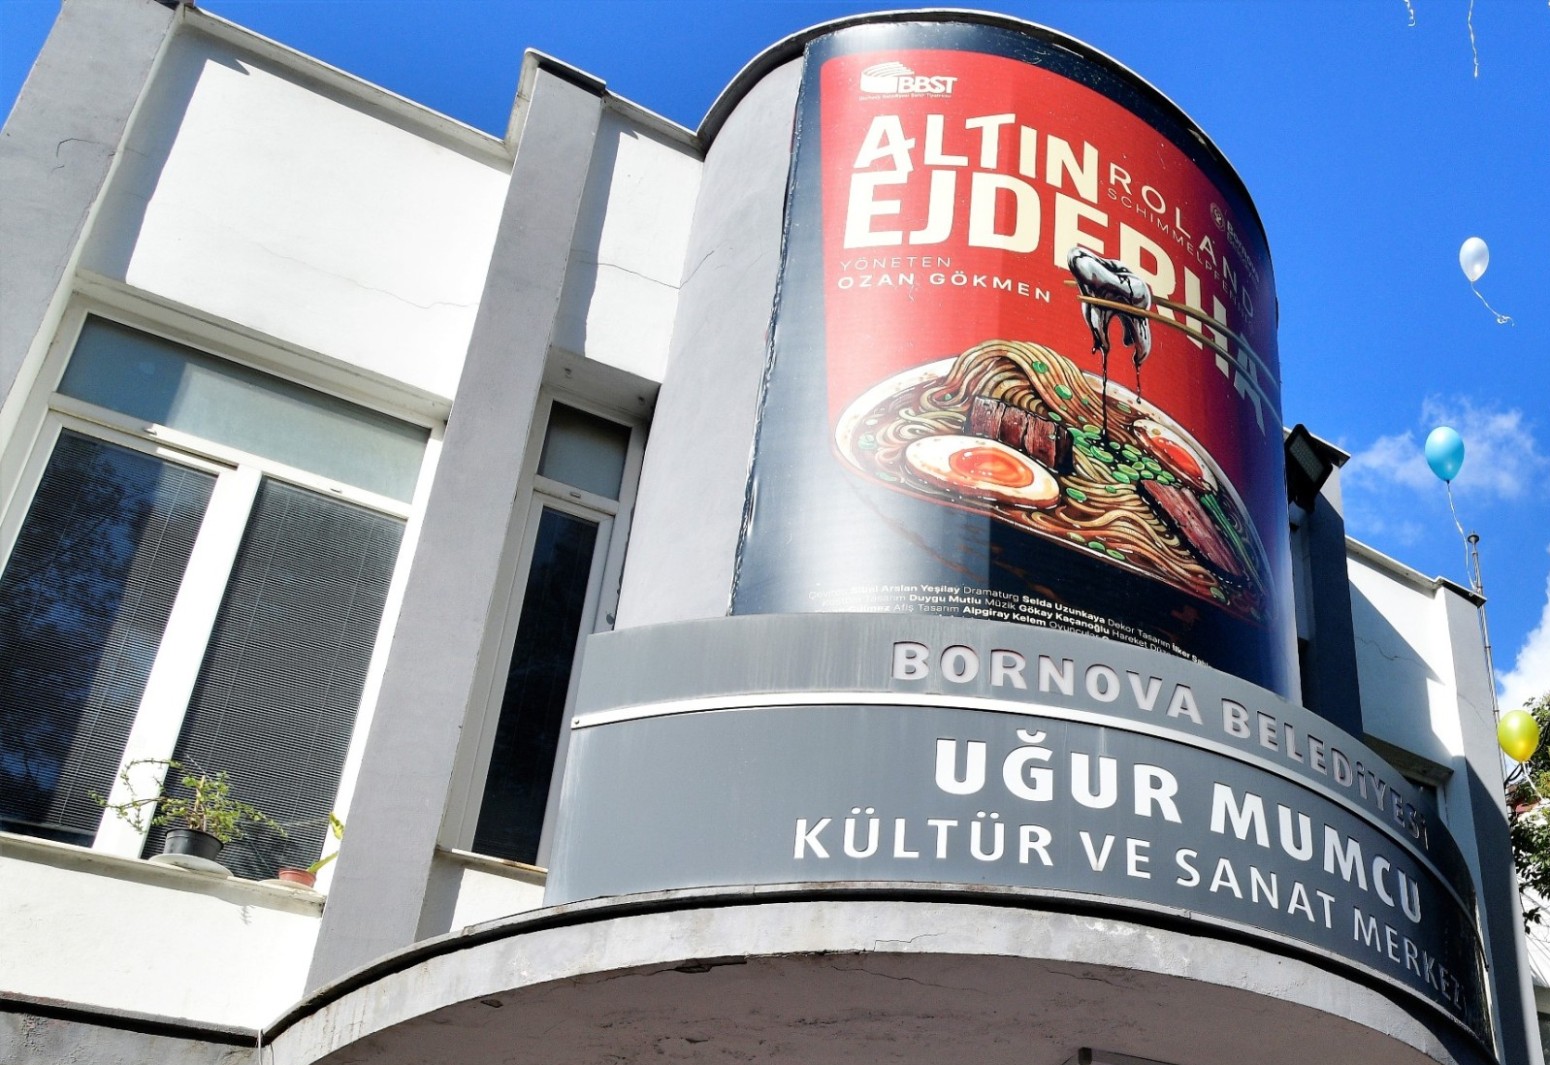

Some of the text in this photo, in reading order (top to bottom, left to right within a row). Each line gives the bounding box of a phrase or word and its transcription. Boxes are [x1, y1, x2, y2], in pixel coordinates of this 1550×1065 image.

[898, 75, 958, 94] BBST
[853, 112, 1099, 205] ALTIN
[840, 255, 951, 270] YÖNETEN
[1109, 162, 1254, 318] ROLAND
[838, 271, 1050, 304] OZAN GÖKMEN
[893, 603, 914, 613] Afiş
[917, 603, 960, 613] Tasarım
[962, 605, 1010, 621] Alpgiray
[1012, 612, 1047, 627] Kelem
[909, 594, 946, 605] Duygu
[948, 594, 982, 604] Mutlu
[984, 597, 1016, 611] Müzik
[1018, 604, 1053, 620] Gökay
[1055, 613, 1110, 636] Kaçanoğlu
[1111, 629, 1148, 651] Hareket
[920, 584, 960, 595] Yeşilay
[963, 586, 1020, 603] Dramaturg
[1022, 595, 1053, 610] Selda
[1054, 602, 1106, 625] Uzunkaya
[1107, 618, 1135, 635] Dekor
[1137, 627, 1171, 650] Tasarım
[892, 641, 1203, 726] BORNOVA
[935, 729, 1422, 924] UĞUR MUMCU
[794, 807, 1054, 867] KÜLTÜR
[1079, 832, 1152, 880] VE
[1175, 846, 1335, 930] SANAT
